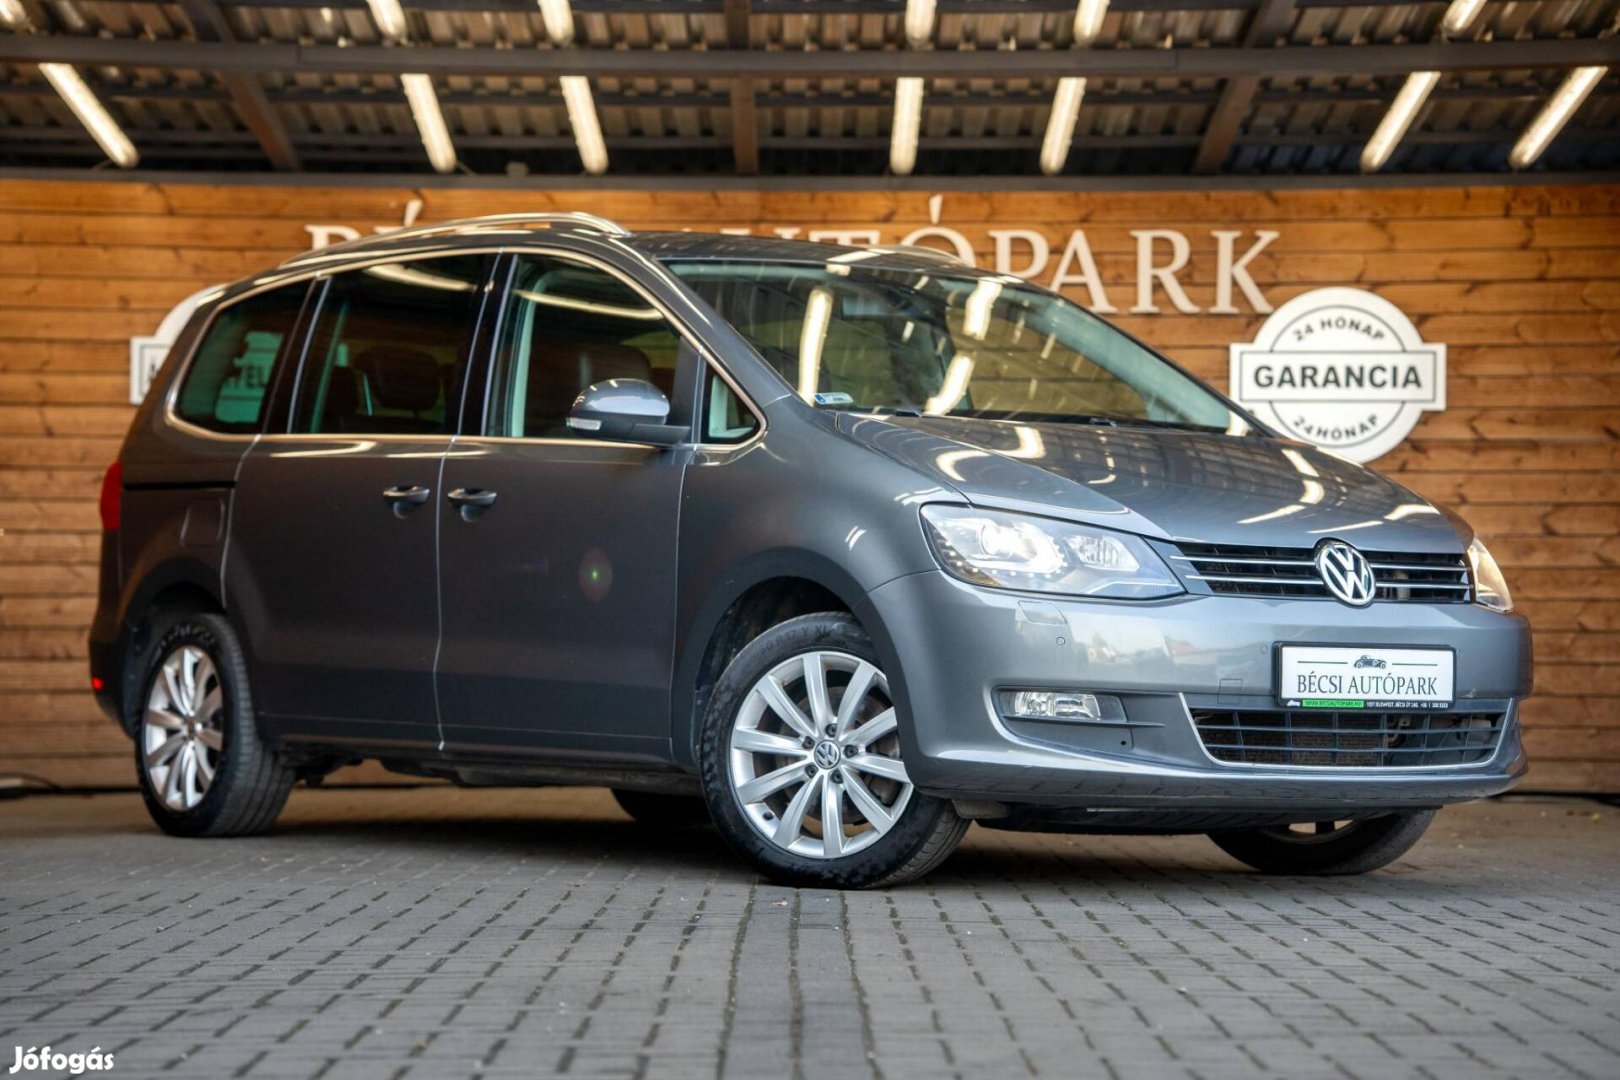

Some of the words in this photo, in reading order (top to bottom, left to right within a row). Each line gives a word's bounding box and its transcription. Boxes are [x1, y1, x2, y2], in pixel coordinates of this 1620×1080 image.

[1293, 325, 1315, 342] 24
[1319, 315, 1386, 342] HÓNAP
[1253, 364, 1423, 389] GARANCIA
[1297, 670, 1343, 694] BÉCSI
[1348, 672, 1438, 696] AUTÓPARK
